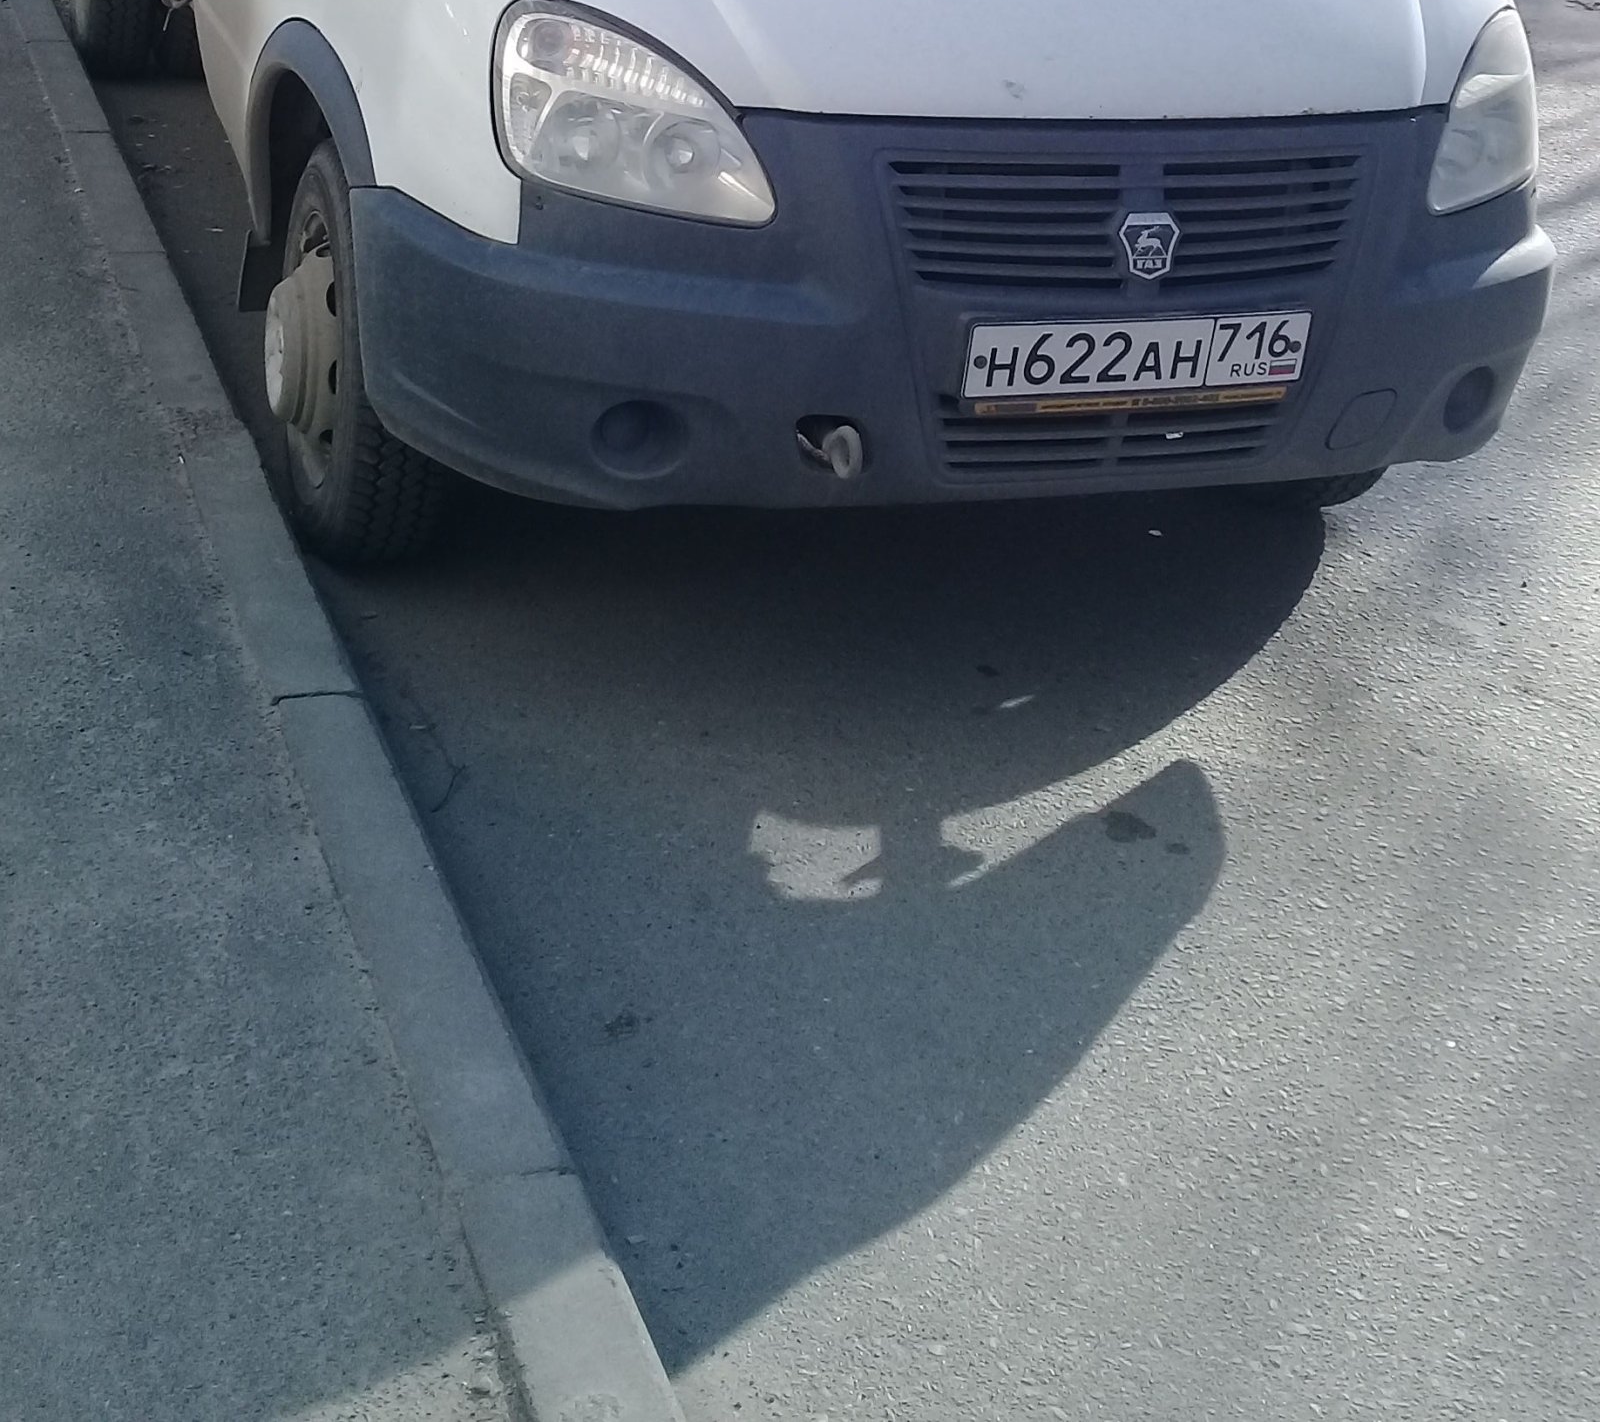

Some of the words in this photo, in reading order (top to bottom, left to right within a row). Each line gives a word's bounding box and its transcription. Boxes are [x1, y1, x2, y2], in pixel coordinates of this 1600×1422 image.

[1136, 259, 1163, 270] ГАЗ
[1216, 319, 1291, 363] 716
[1229, 362, 1268, 378] RUS
